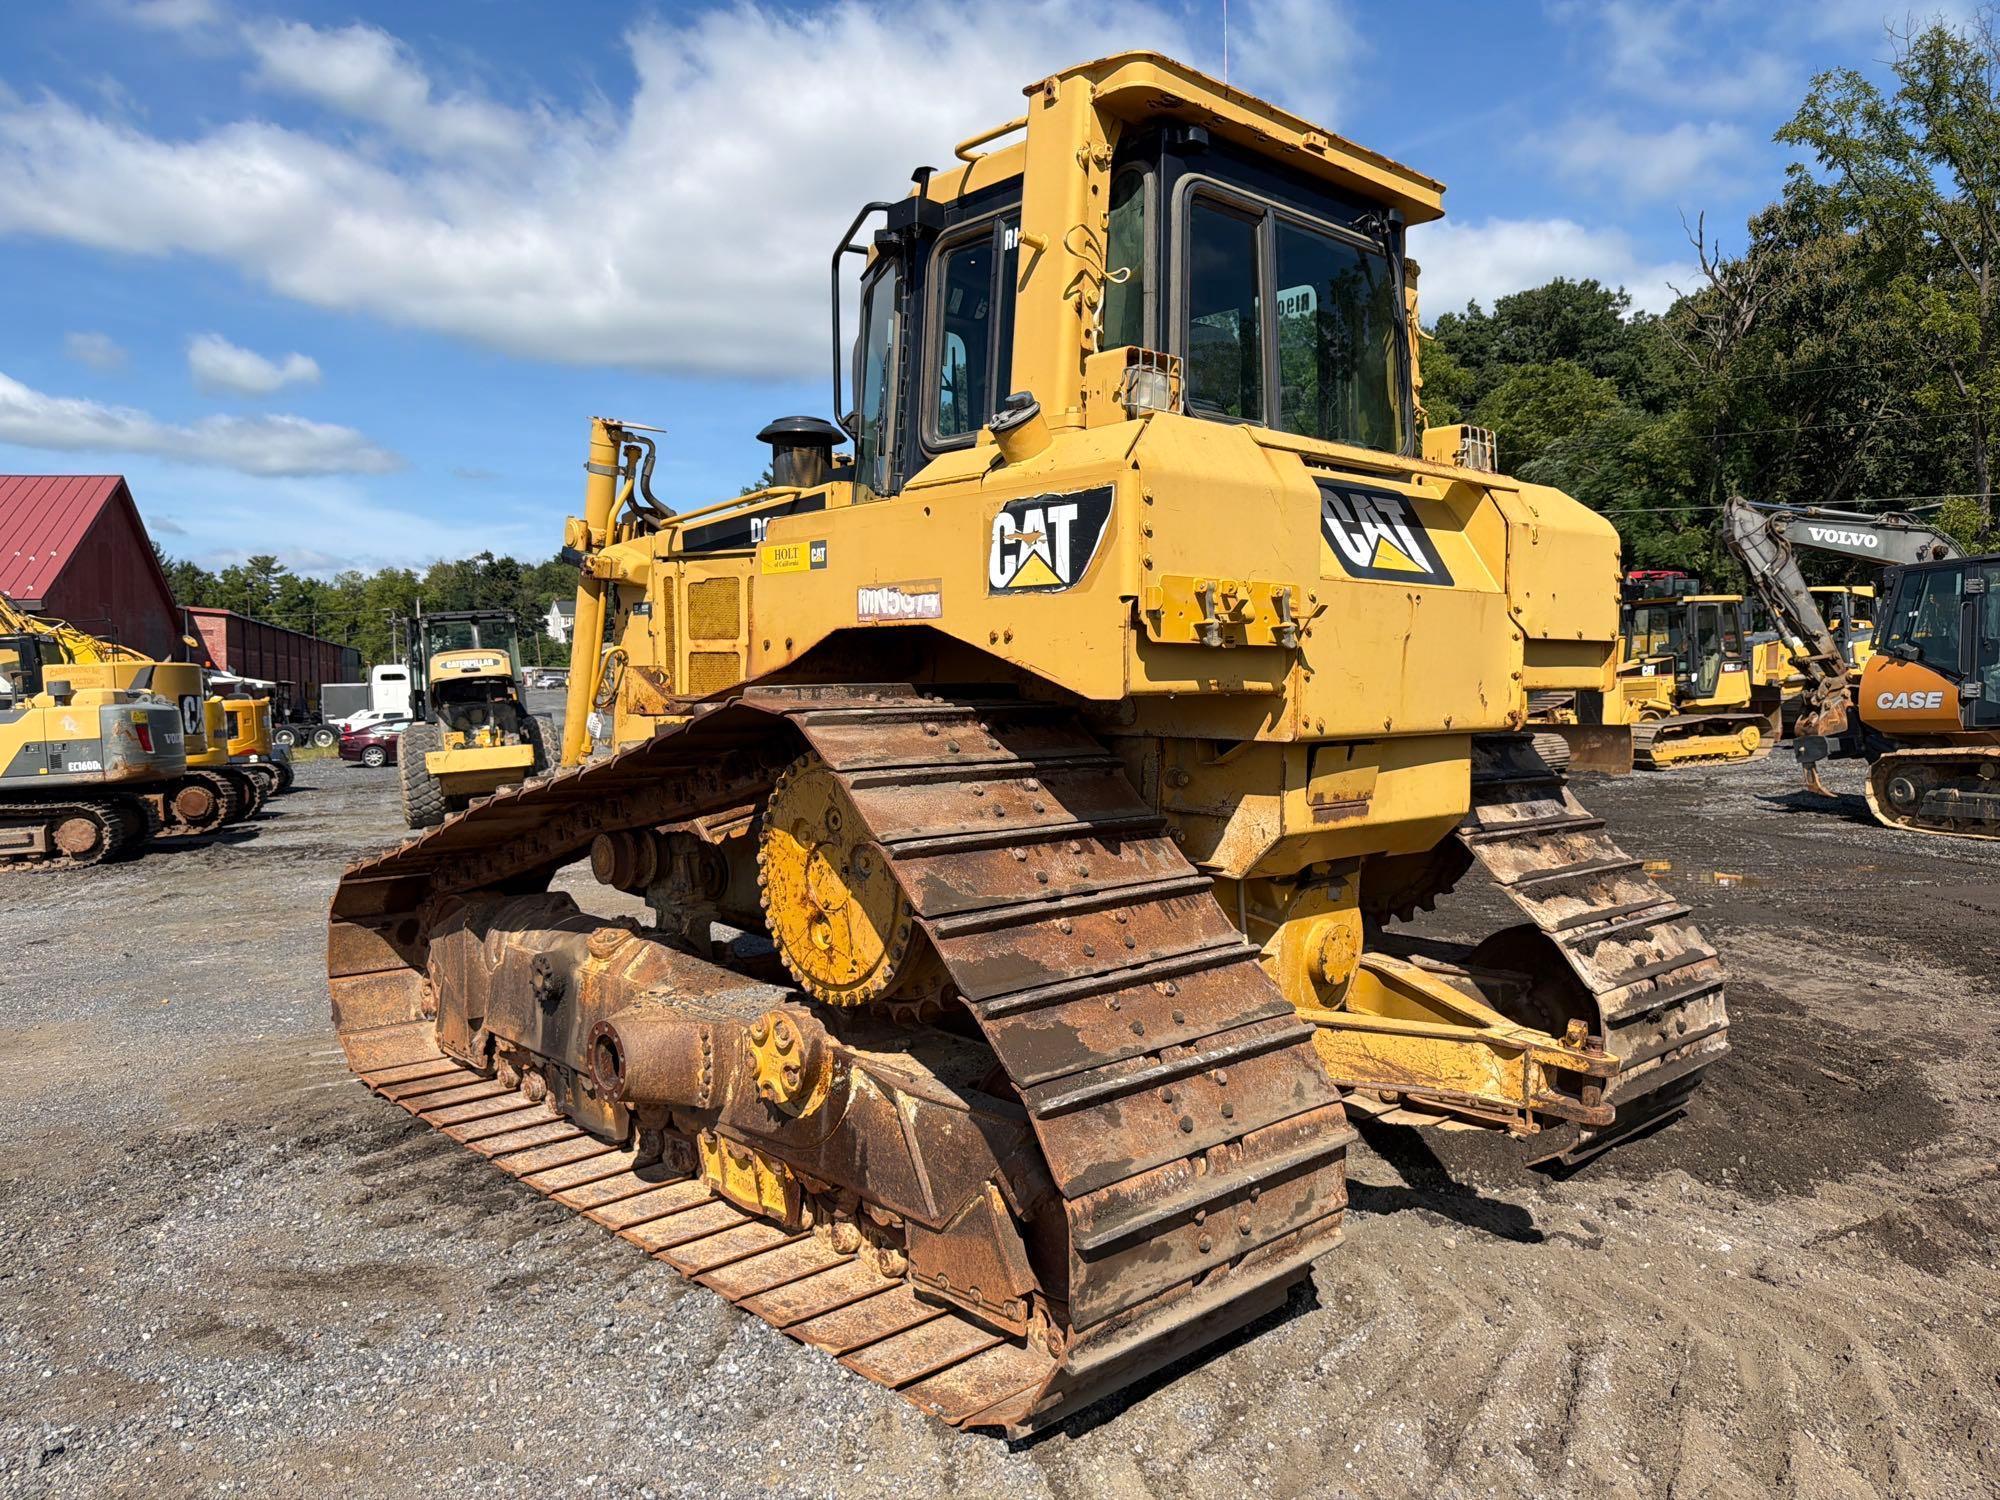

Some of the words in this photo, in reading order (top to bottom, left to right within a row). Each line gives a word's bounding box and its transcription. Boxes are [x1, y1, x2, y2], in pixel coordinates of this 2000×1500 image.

[1320, 487, 1434, 574] CAT
[1808, 527, 1878, 548] VOLVO
[774, 547, 800, 561] HOLT
[811, 547, 826, 563] CAT
[990, 504, 1078, 589] CAT
[446, 658, 494, 668] CATERPILLAR
[1642, 665, 1656, 677] CAT
[1876, 691, 1944, 710] CASE
